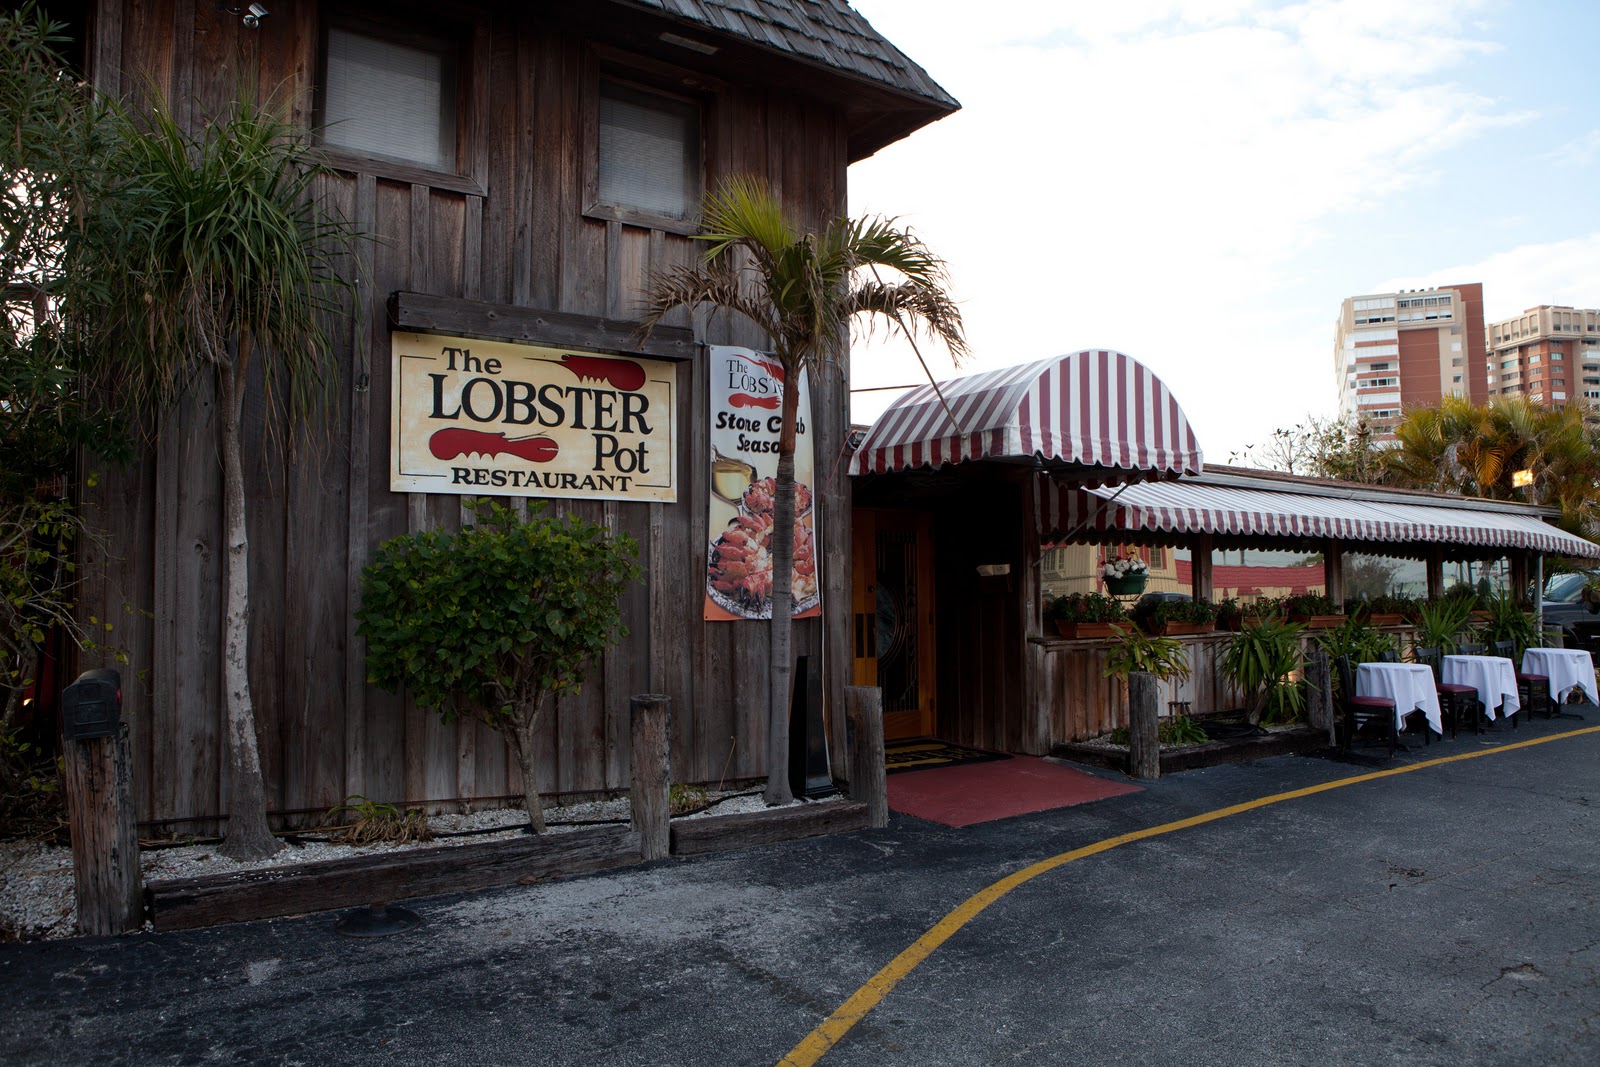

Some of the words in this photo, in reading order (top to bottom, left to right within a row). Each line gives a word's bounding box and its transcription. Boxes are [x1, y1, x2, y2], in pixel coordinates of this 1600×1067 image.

[441, 347, 502, 374] The
[726, 360, 748, 373] The
[728, 373, 800, 397] LOBST
[428, 373, 653, 435] LOBSTER
[716, 411, 760, 432] Stone
[767, 416, 805, 435] Cab
[592, 433, 650, 474] Pot
[737, 433, 781, 454] Seaso
[451, 467, 633, 492] RESTAURANT
